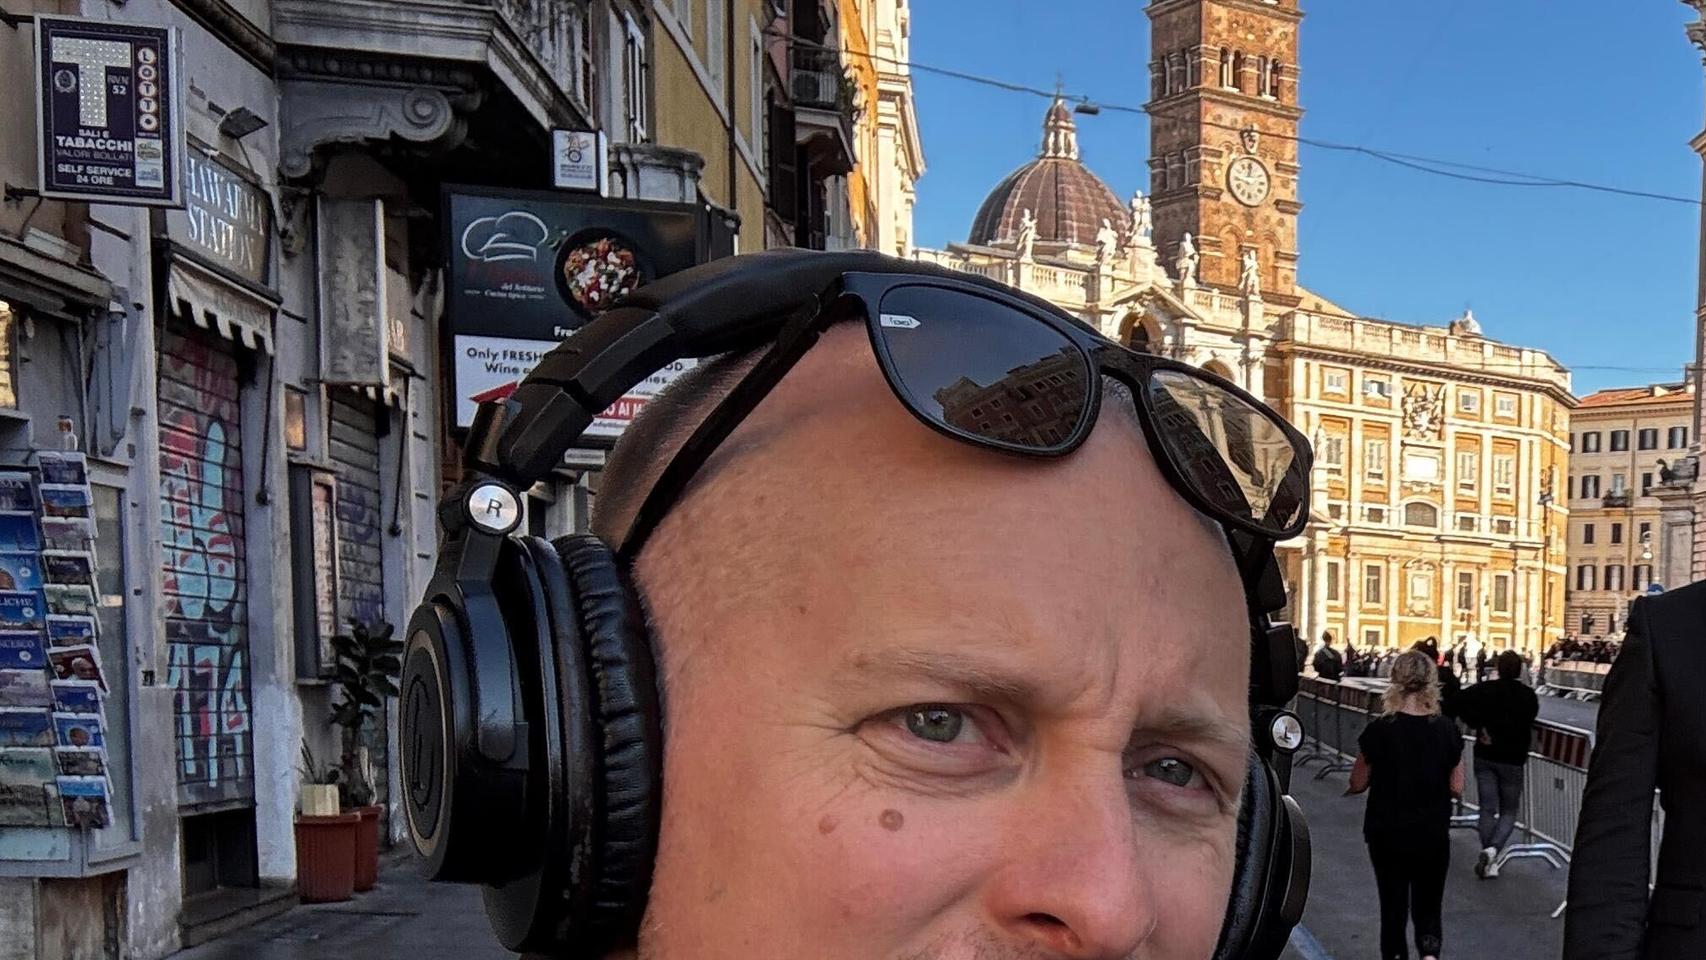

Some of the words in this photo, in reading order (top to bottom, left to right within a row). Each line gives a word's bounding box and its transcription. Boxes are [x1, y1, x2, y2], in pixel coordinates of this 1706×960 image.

[52, 37, 131, 127] T
[138, 48, 157, 130] LOTTO
[112, 85, 126, 95] 52
[79, 129, 101, 138] SALI
[56, 136, 132, 152] TABACCHI
[56, 149, 91, 159] VALORI
[57, 164, 84, 173] SELF
[86, 166, 132, 178] SERVICE
[76, 175, 89, 184] 24
[90, 176, 114, 185] ORE
[466, 347, 499, 361] Only
[485, 361, 520, 374] Wine
[486, 498, 503, 518] R
[1284, 725, 1292, 740] L
